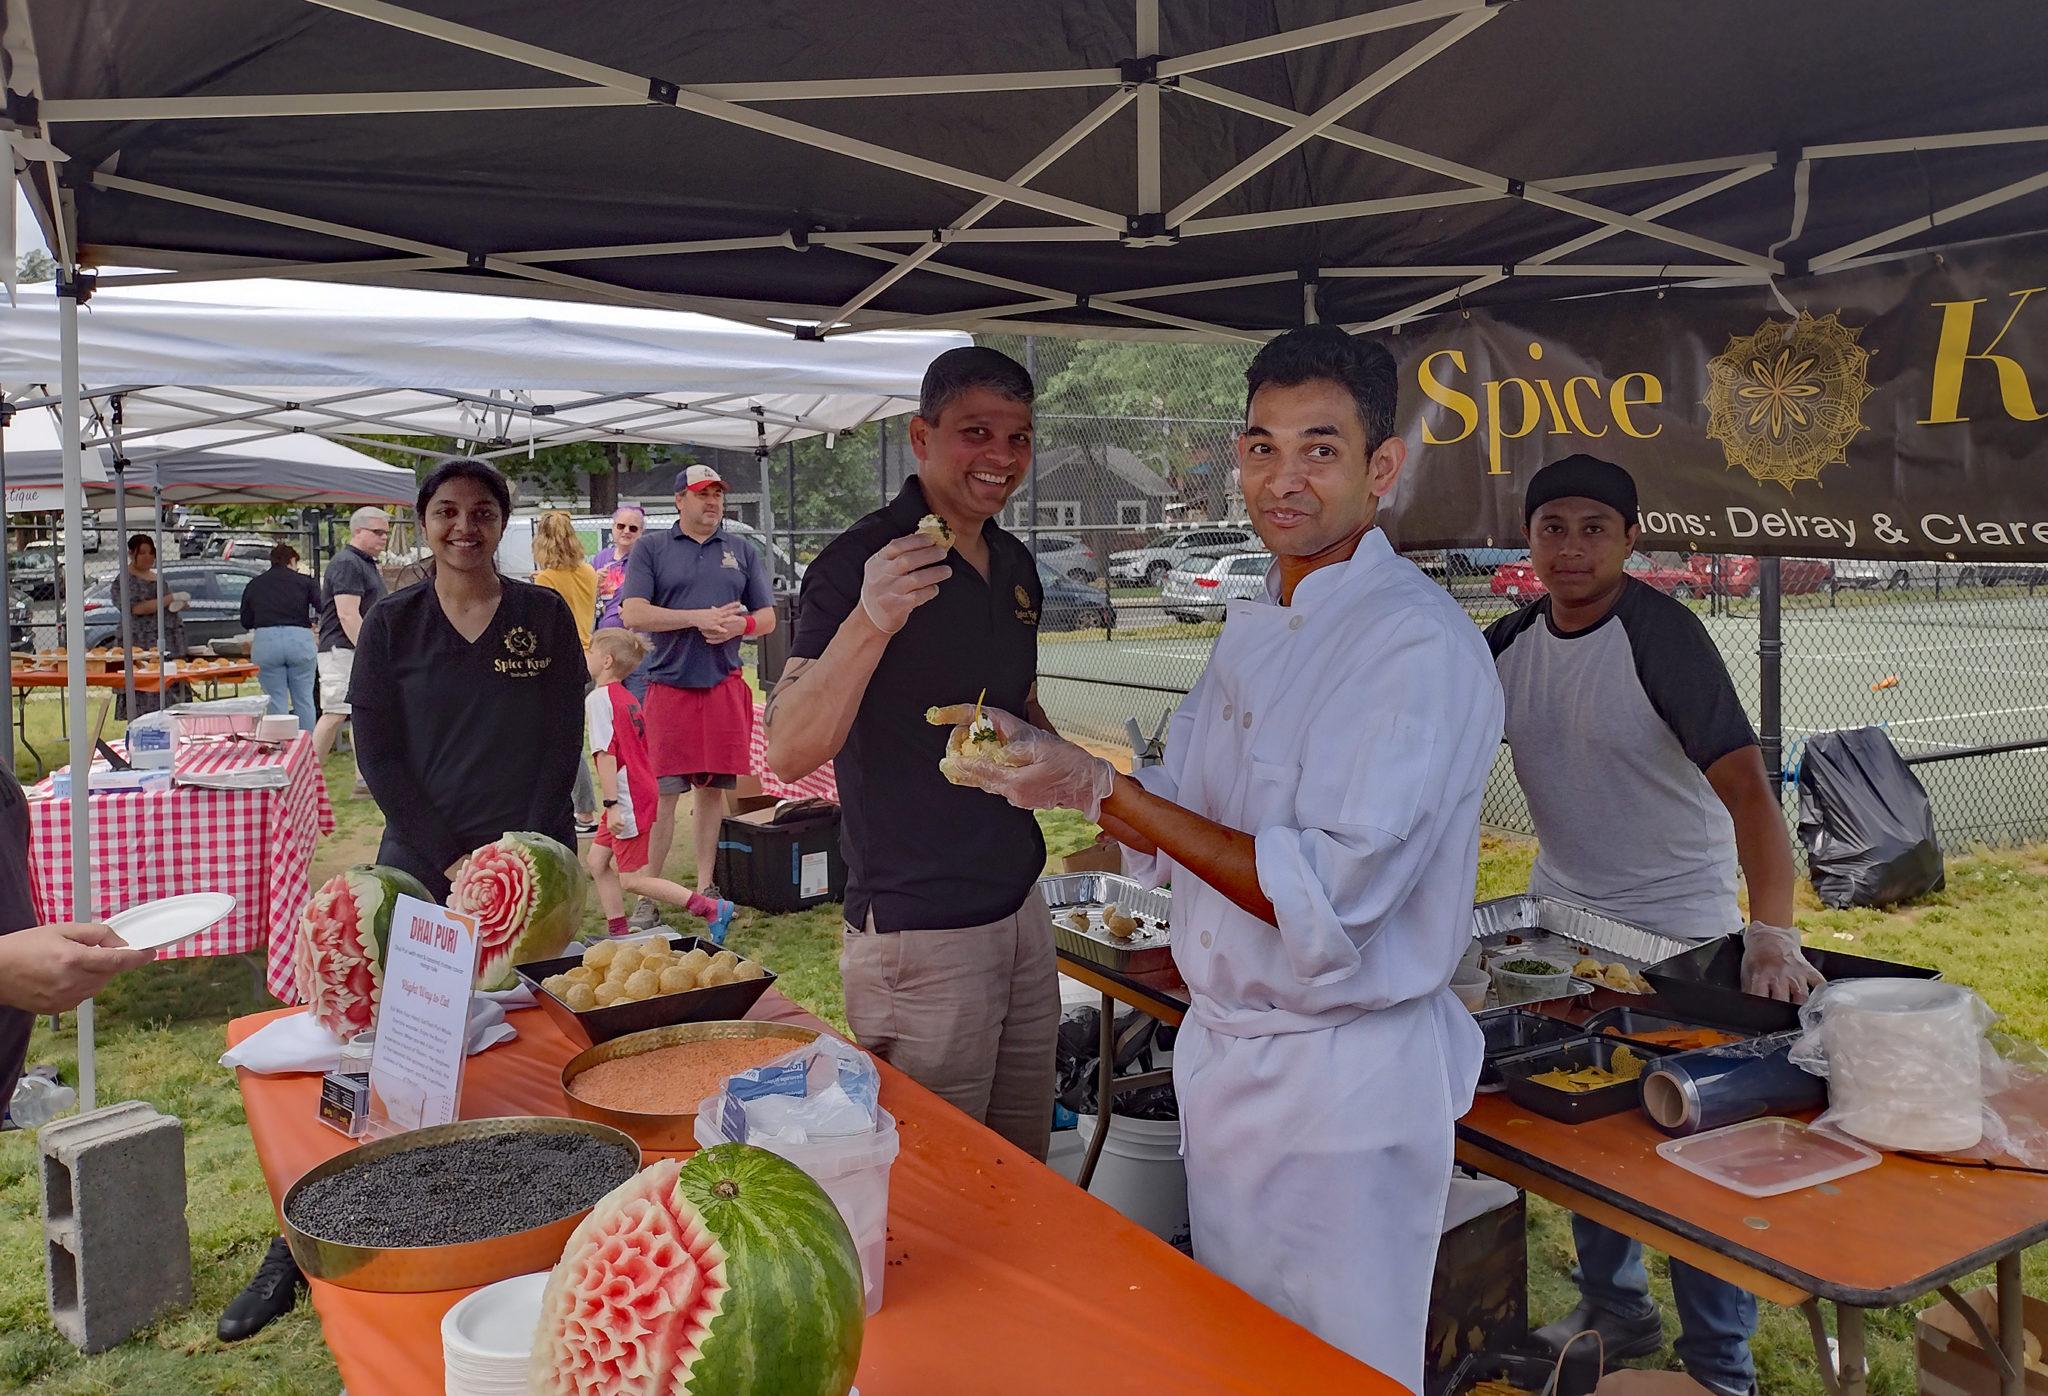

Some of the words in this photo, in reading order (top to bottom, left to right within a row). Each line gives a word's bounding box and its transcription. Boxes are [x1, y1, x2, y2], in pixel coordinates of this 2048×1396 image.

[1417, 342, 1662, 475] Spice
[1916, 286, 2048, 425] K
[1726, 506, 1857, 548] Delray
[1872, 513, 1909, 544] &
[494, 658, 523, 673] Spice
[410, 916, 434, 945] DHAI
[434, 924, 458, 954] PURI
